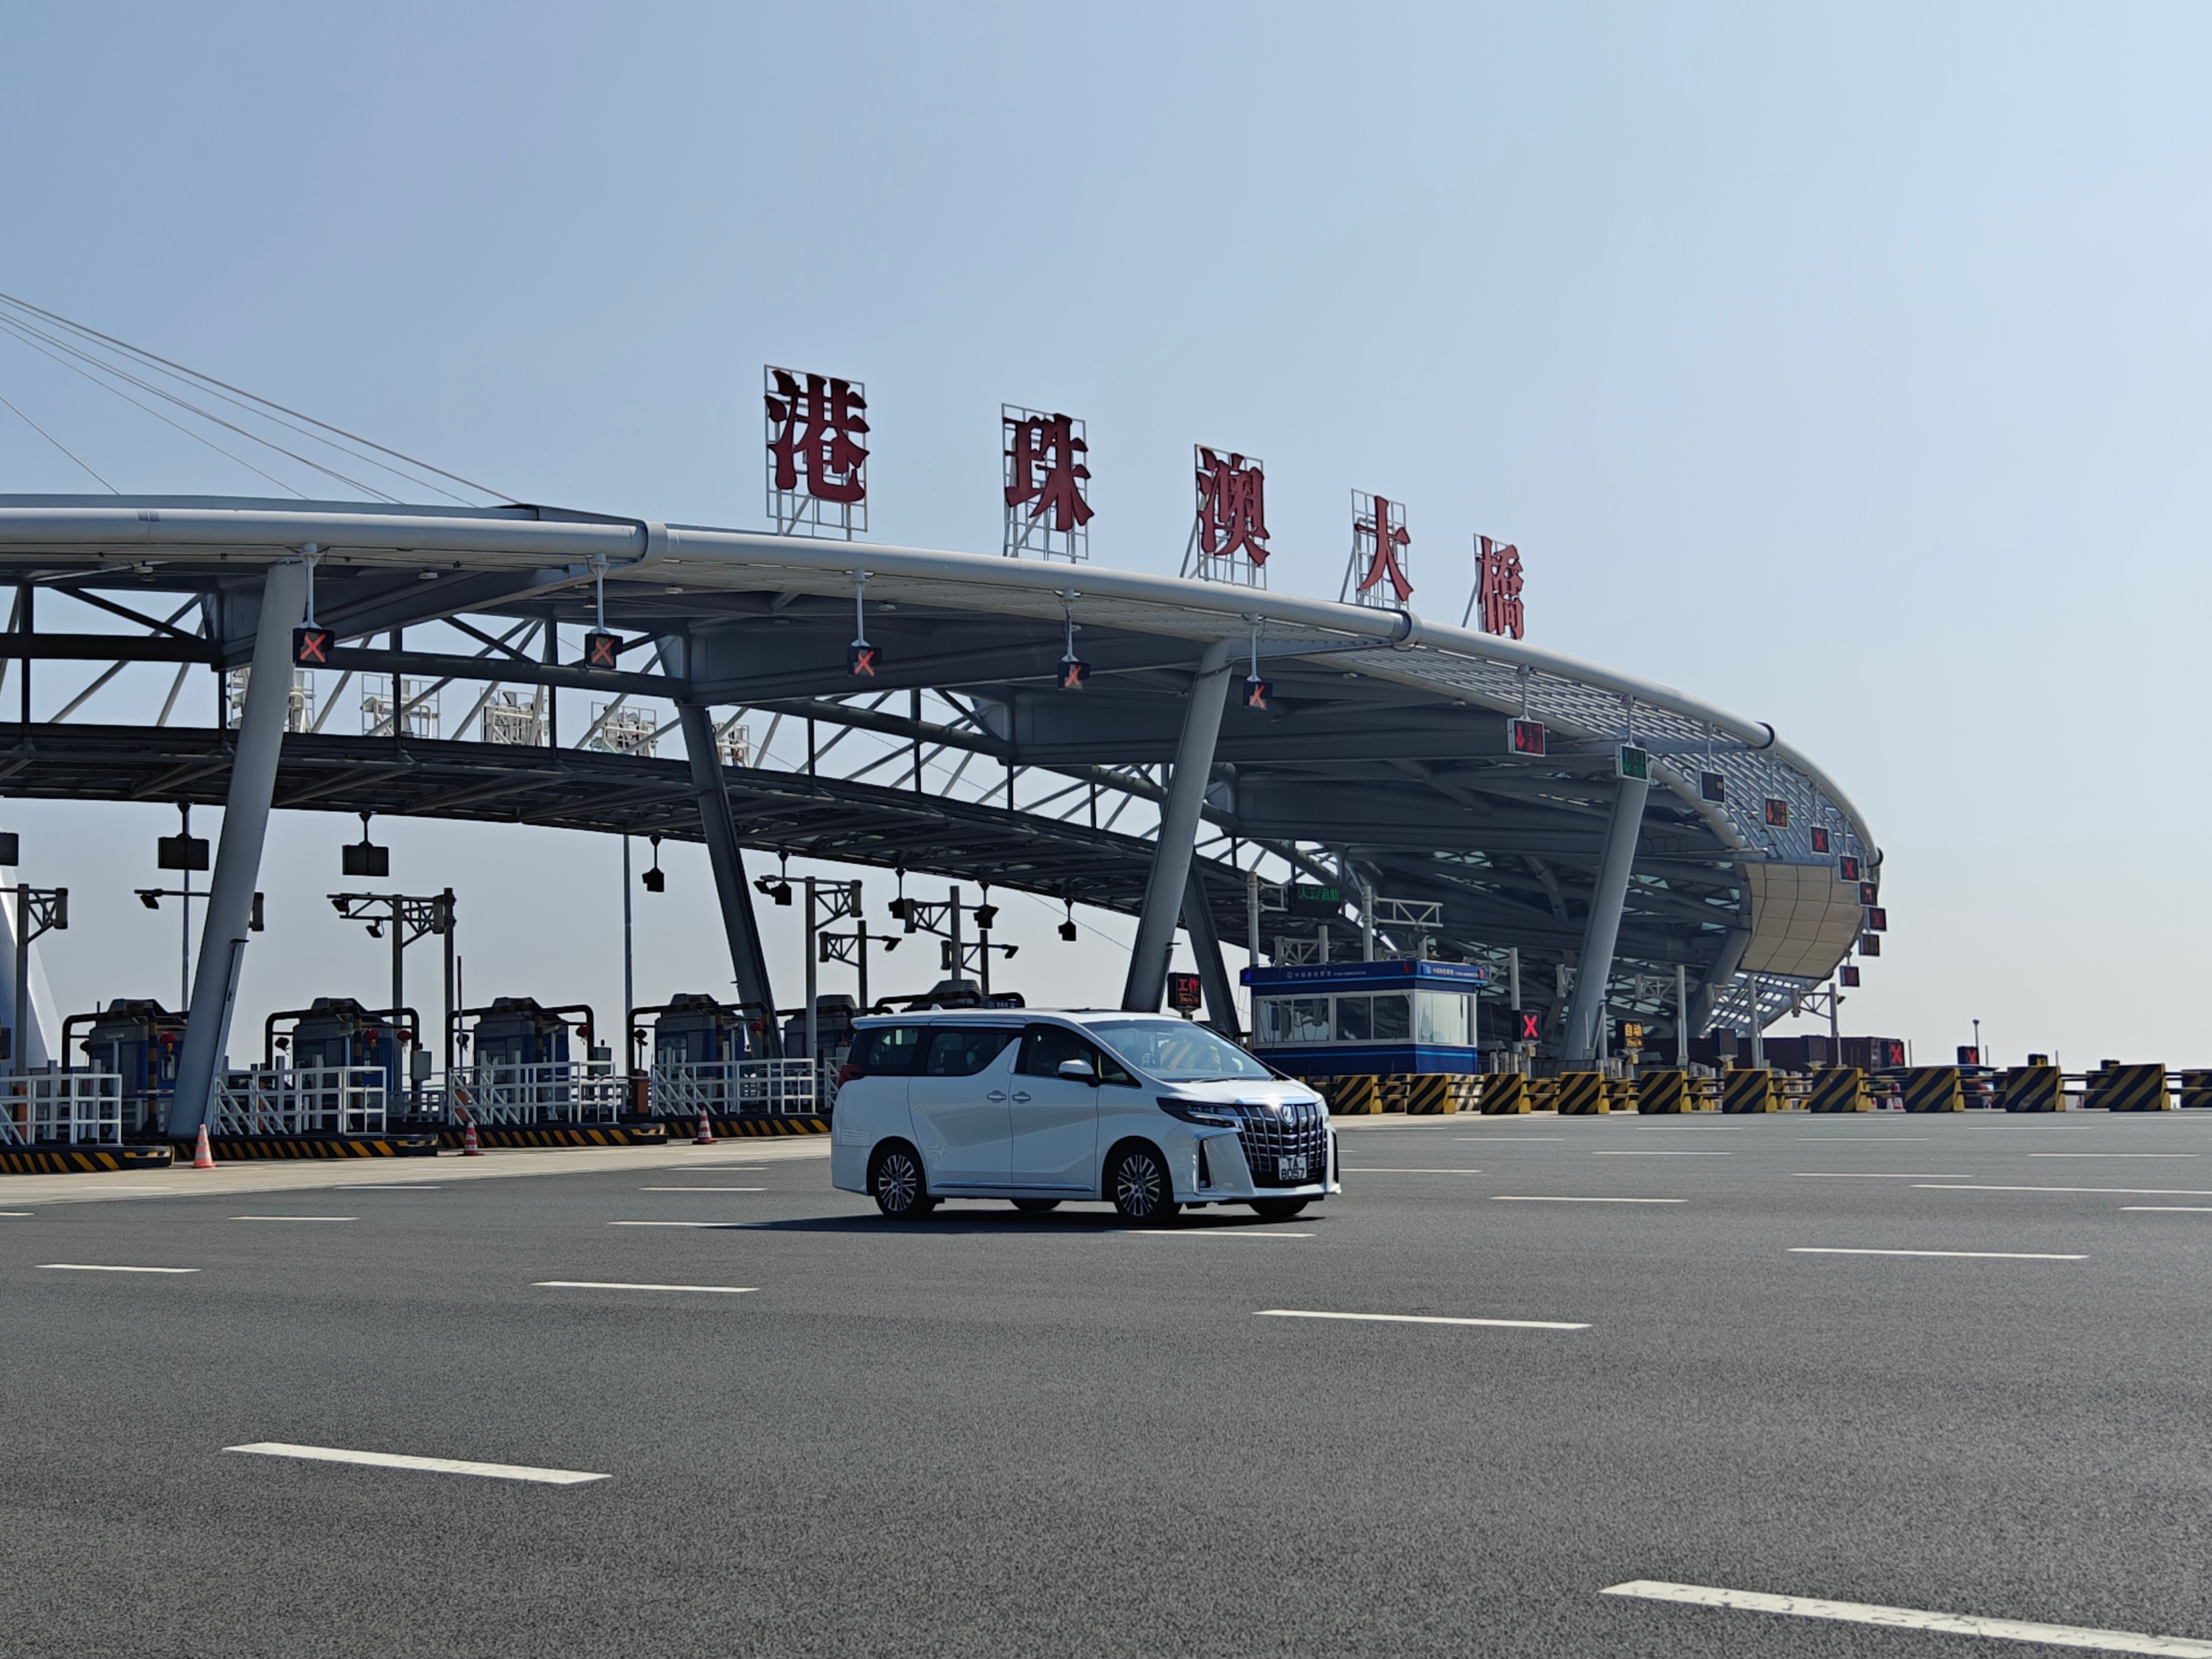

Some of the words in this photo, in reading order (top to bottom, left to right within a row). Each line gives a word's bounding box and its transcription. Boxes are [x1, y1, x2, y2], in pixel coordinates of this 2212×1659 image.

[764, 369, 1524, 640] 港珠澳大橋
[1287, 1158, 1299, 1169] TA
[1281, 1168, 1305, 1180] 8057
